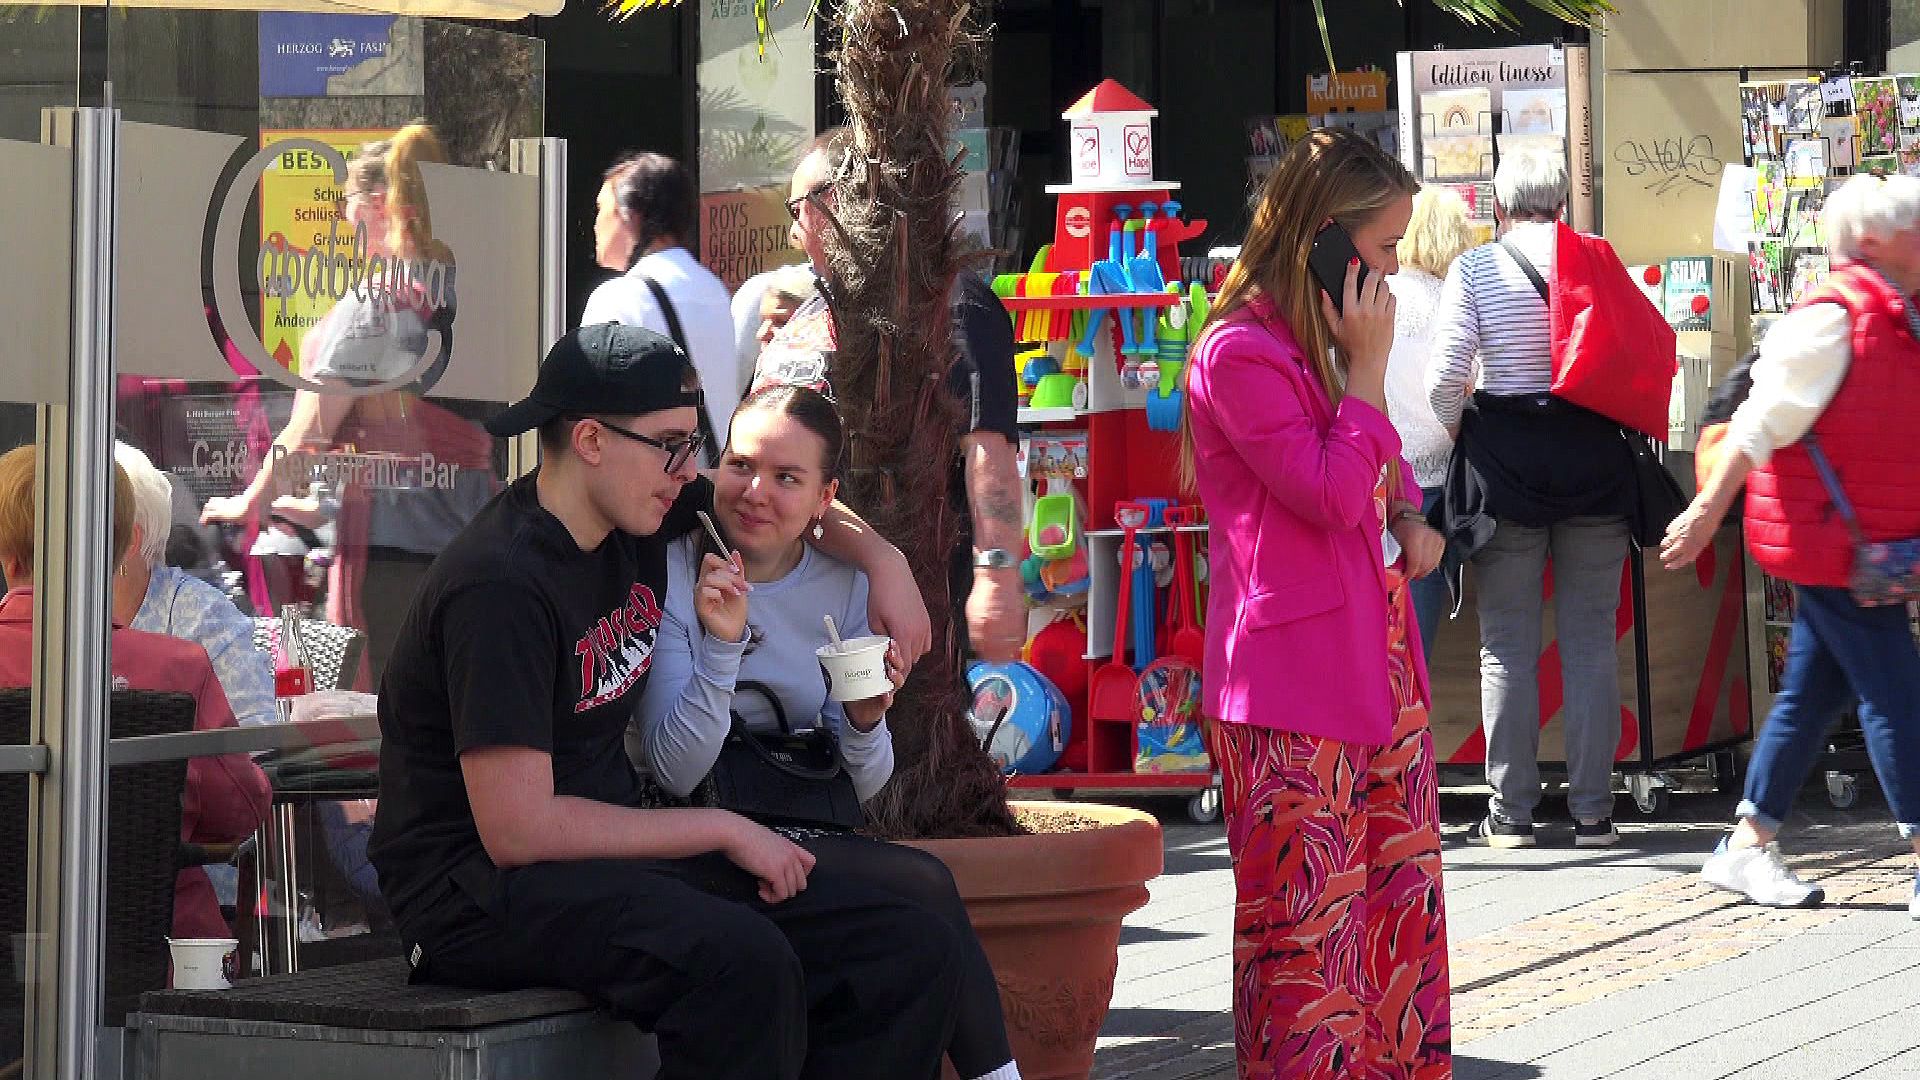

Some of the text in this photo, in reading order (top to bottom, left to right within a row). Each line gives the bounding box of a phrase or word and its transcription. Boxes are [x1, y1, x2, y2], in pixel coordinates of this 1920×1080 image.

[277, 43, 323, 54] HERZOG
[1431, 61, 1557, 87] Edition Finesse
[709, 202, 748, 232] ROYS
[709, 224, 796, 258] GEBURTSTA
[421, 453, 459, 490] Bar
